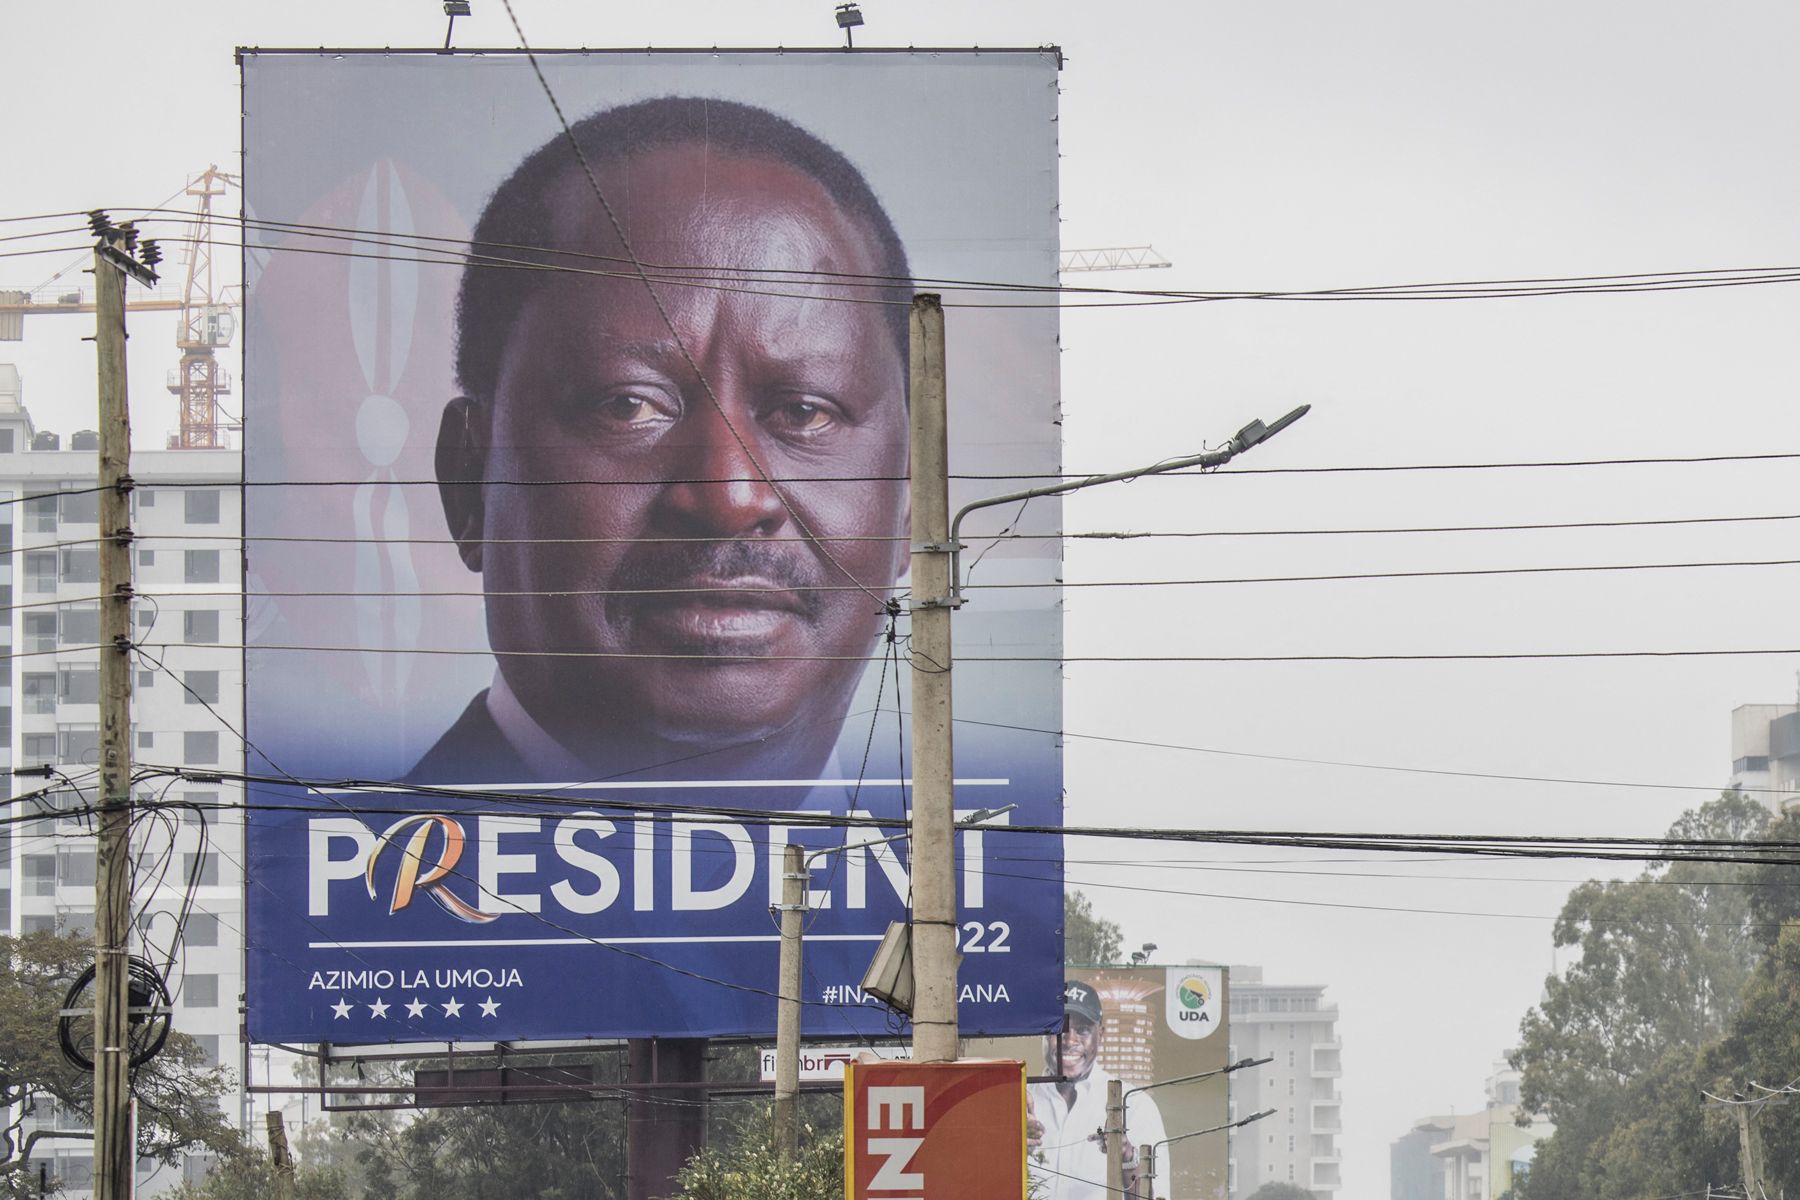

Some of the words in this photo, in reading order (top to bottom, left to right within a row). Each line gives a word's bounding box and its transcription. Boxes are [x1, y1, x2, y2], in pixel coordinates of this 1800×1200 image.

[308, 809, 1009, 923] PRESIDENT
[308, 971, 394, 990] AZIMIO
[400, 970, 430, 988] LA
[435, 968, 523, 988] UMOJA
[1179, 1011, 1209, 1022] UDA
